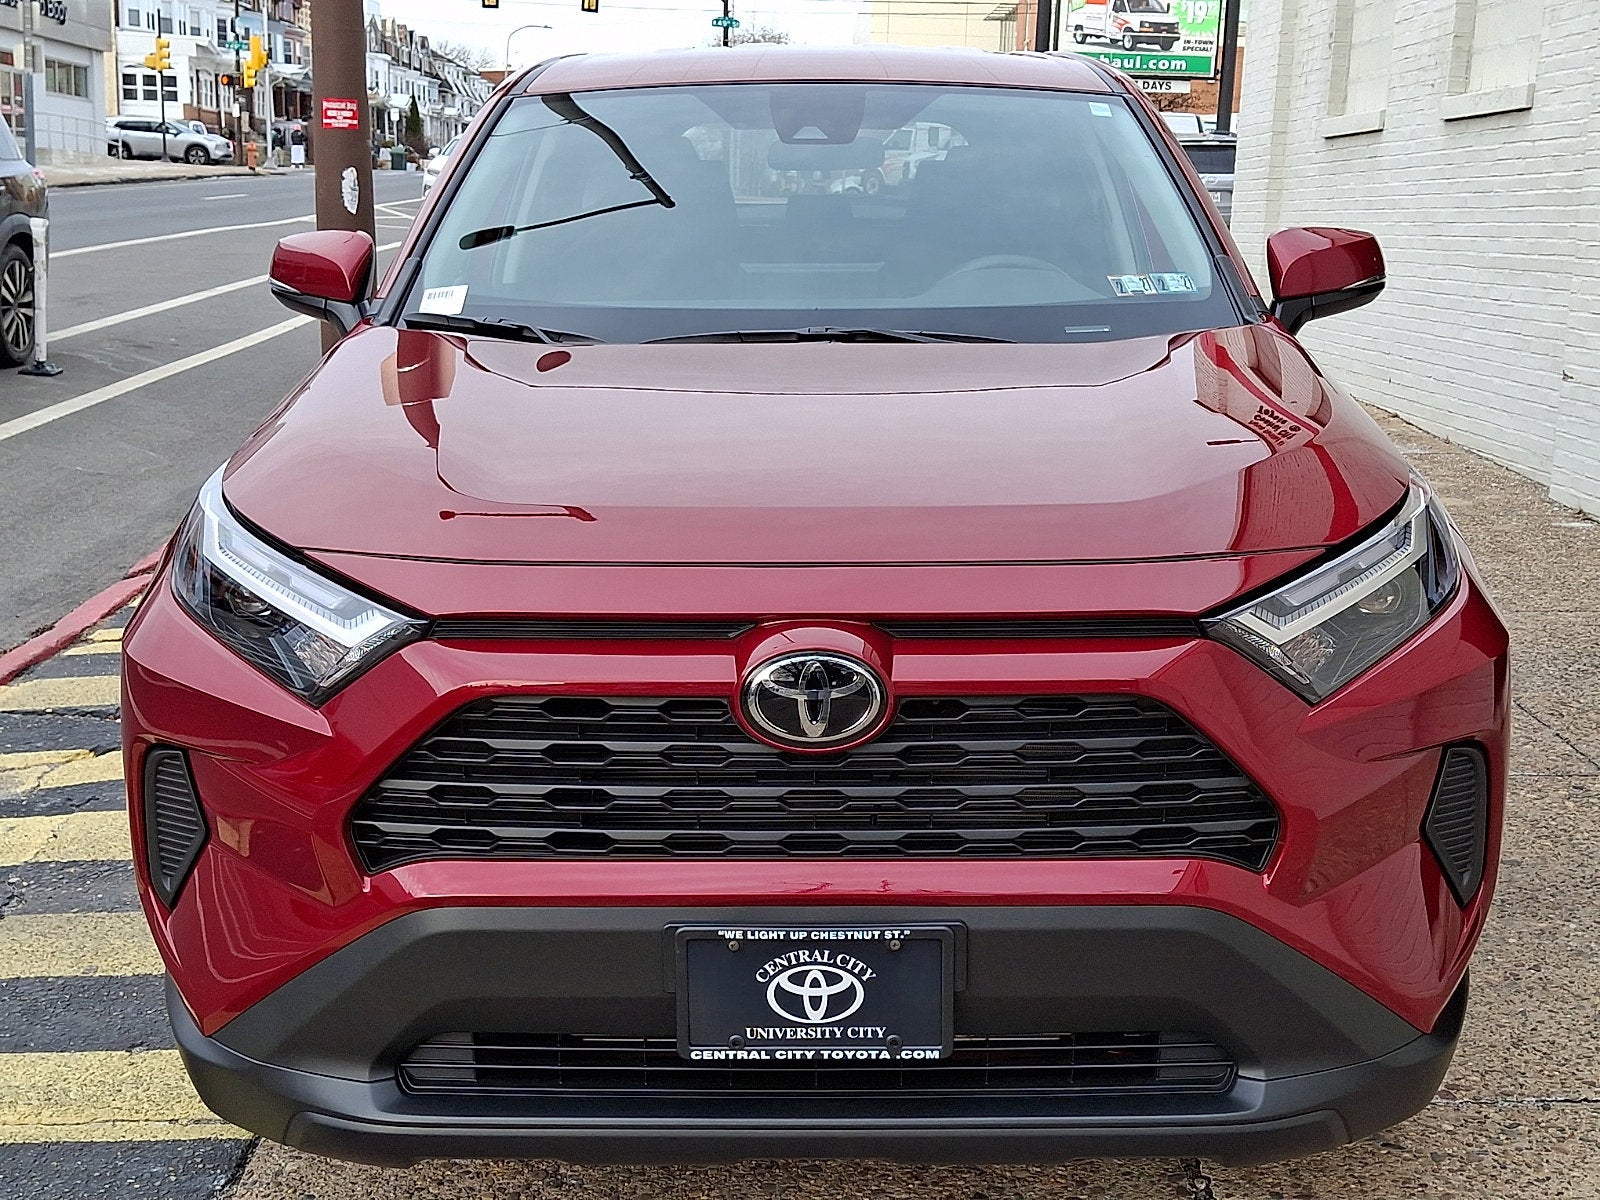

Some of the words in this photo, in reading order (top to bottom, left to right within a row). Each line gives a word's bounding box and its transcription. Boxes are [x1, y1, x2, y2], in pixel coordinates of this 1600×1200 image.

[1142, 81, 1172, 91] DAYS
[747, 930, 786, 940] LIGHT
[789, 931, 808, 940] UP
[810, 930, 881, 940] CHESTNUT
[755, 949, 834, 983] CENTRAL
[836, 953, 877, 983] CITY
[745, 1027, 844, 1040] UNIVERSITY
[846, 1026, 887, 1039] CITY
[690, 1050, 771, 1060] CENTRAL
[774, 1050, 816, 1060] CITY
[820, 1050, 891, 1060] TOYOTA
[895, 1050, 940, 1060] .COM
